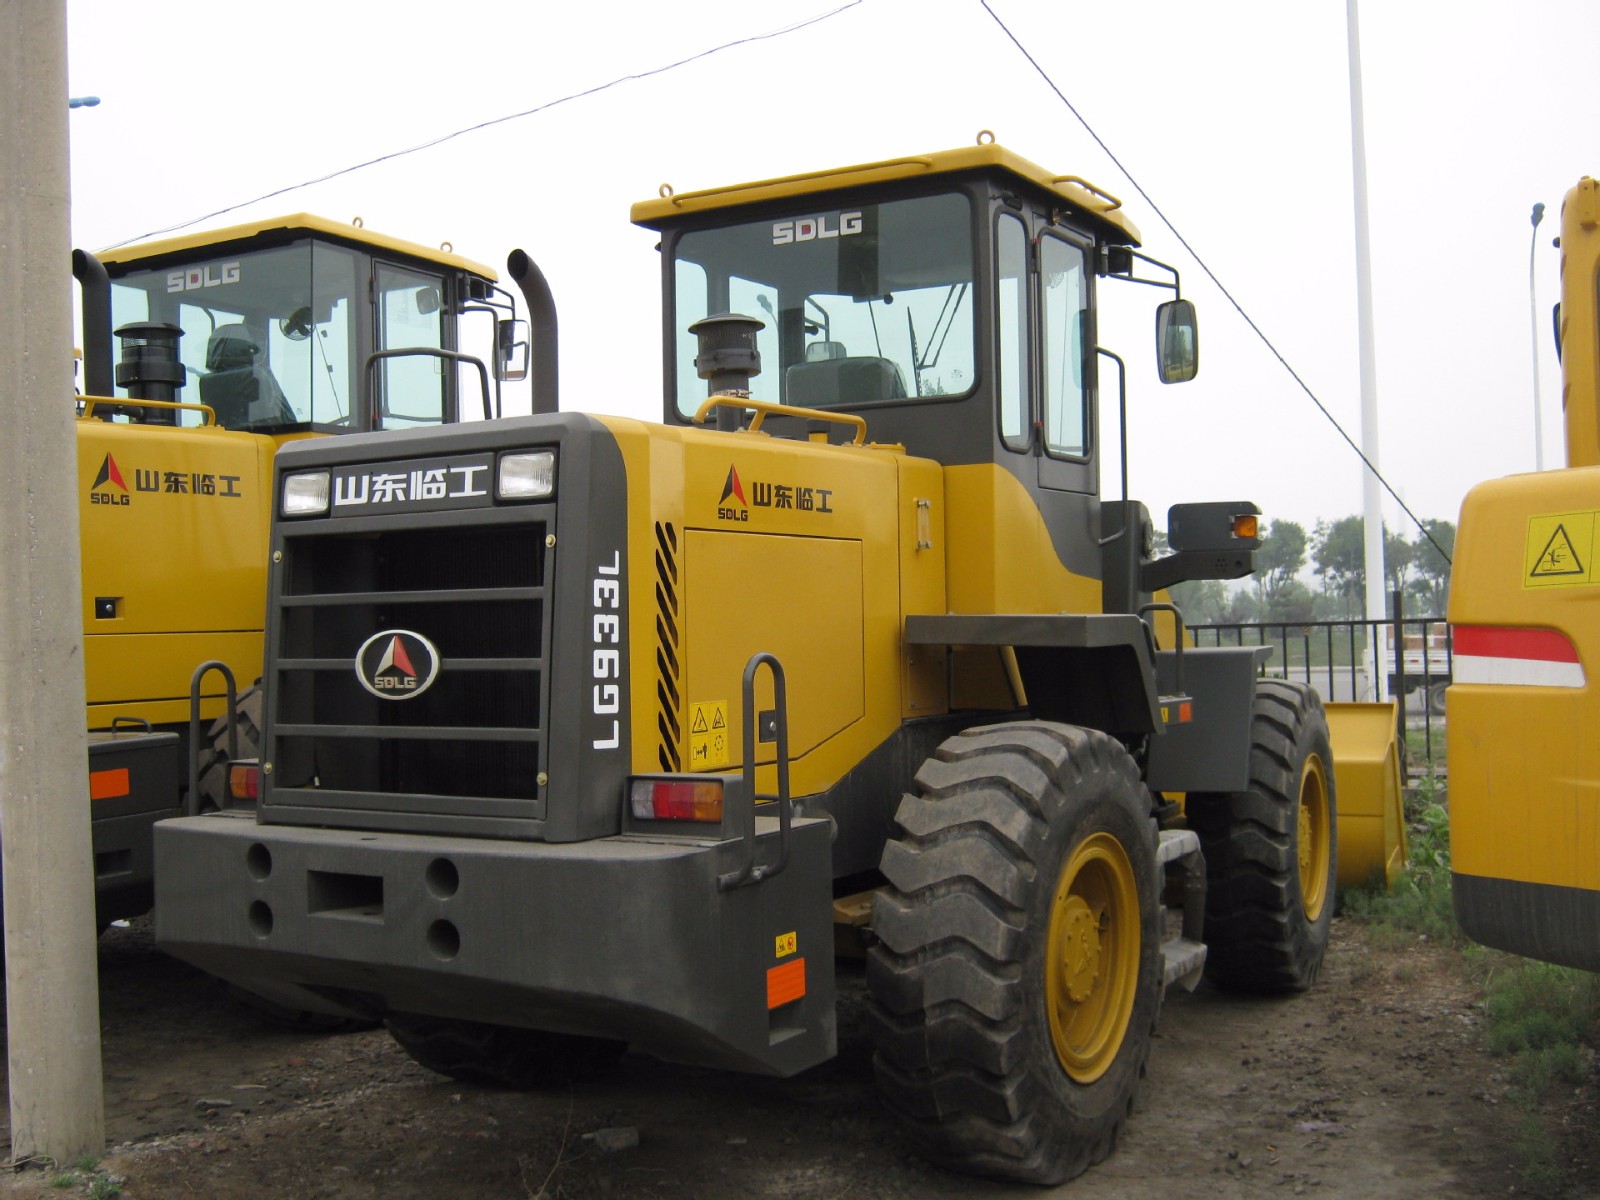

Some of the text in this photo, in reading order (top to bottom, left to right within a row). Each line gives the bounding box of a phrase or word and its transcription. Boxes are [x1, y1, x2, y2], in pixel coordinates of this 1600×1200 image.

[772, 211, 863, 246] SDLG
[166, 261, 241, 294] SDLG
[90, 492, 131, 506] SDLG
[135, 468, 242, 498] 山东临工
[334, 464, 489, 506] 山东临工
[752, 481, 833, 514] 山东临工
[717, 507, 749, 522] SDLG
[593, 550, 620, 750] LG933L
[374, 676, 417, 689] SDLG
